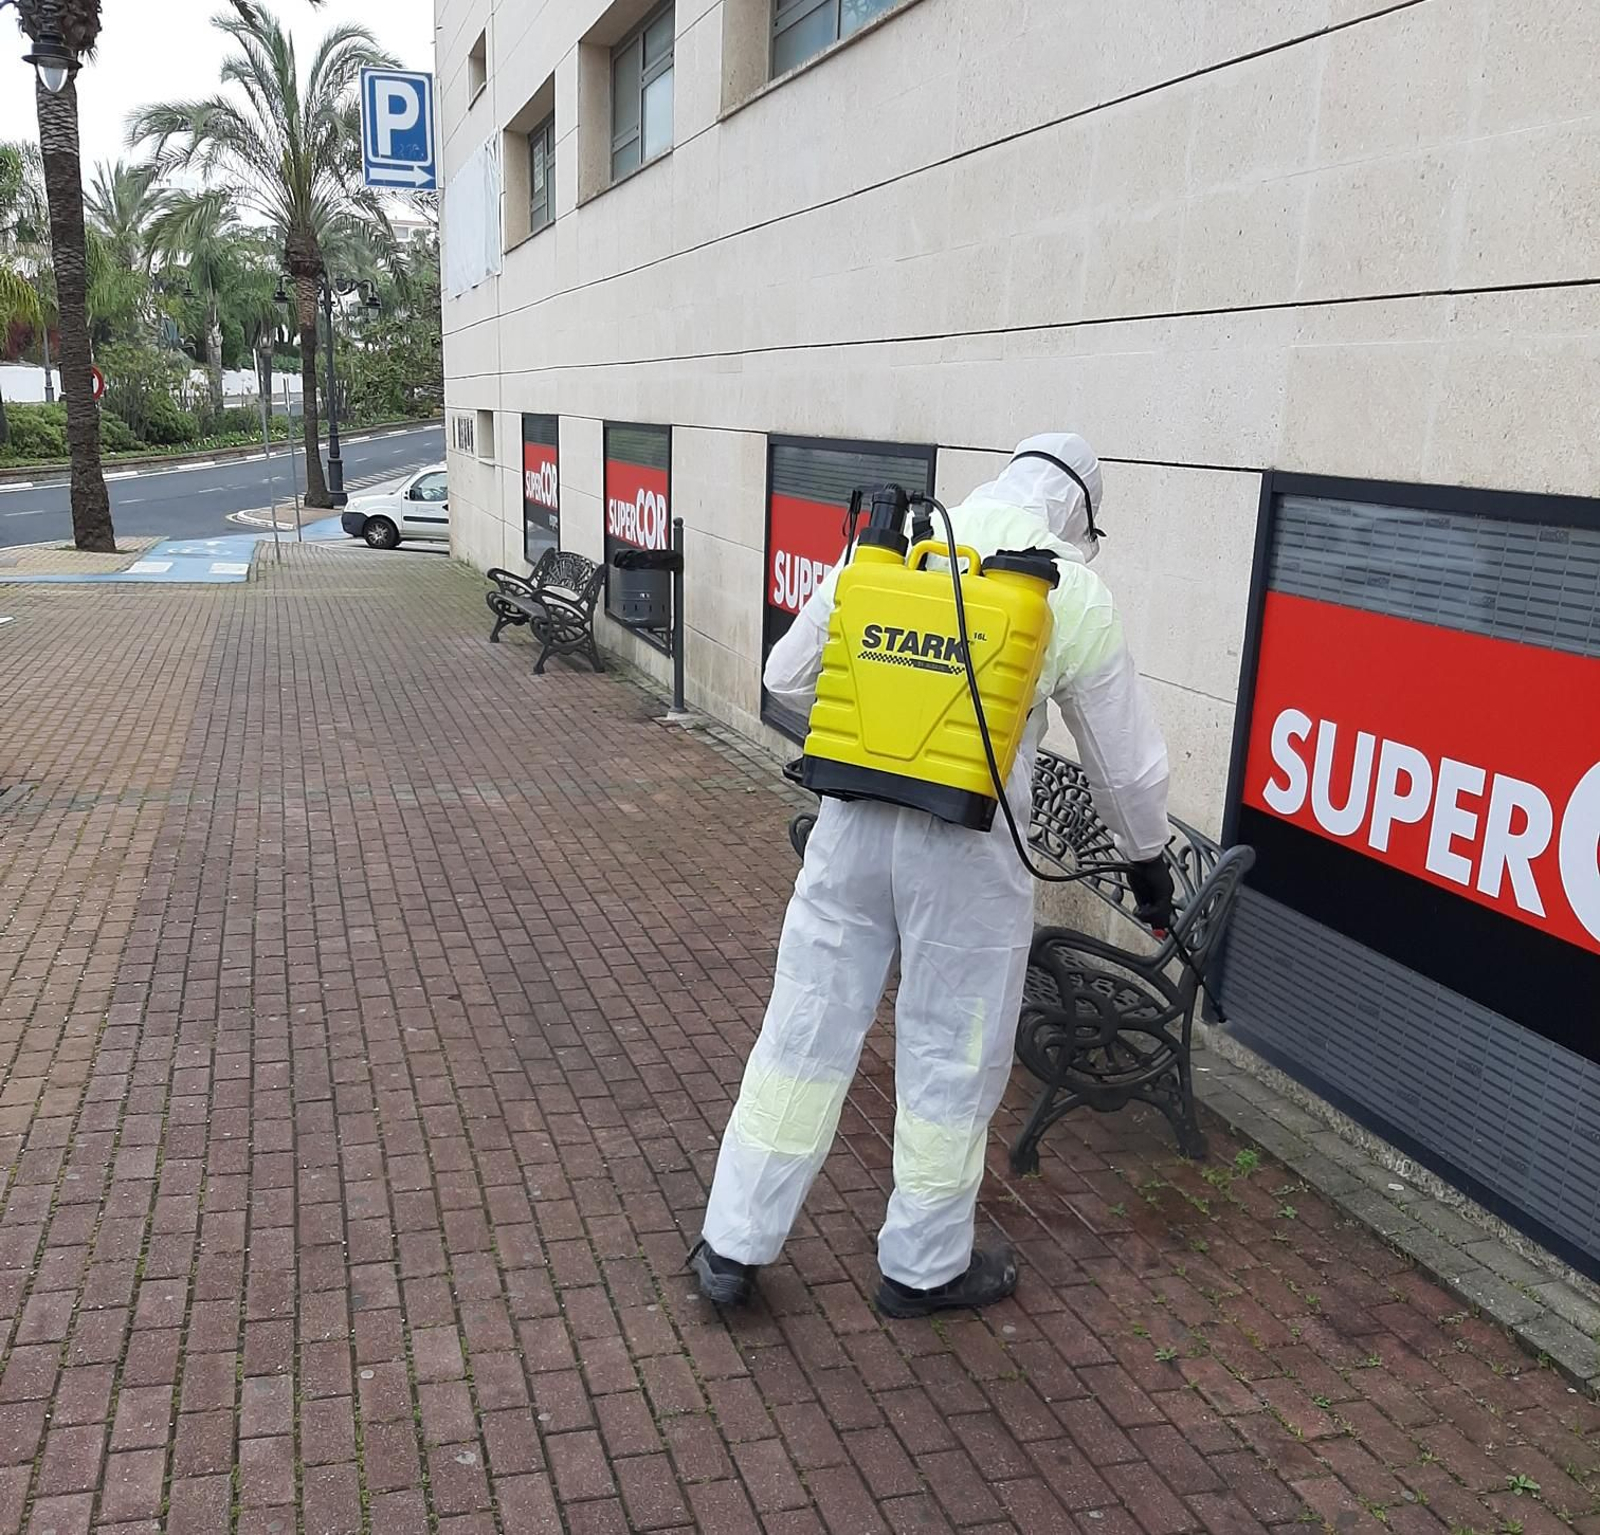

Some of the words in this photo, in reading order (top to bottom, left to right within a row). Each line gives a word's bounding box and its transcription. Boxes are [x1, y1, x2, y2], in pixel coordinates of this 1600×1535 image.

[375, 79, 420, 156] P
[608, 488, 667, 550] SUPERCOR
[773, 550, 833, 610] SUPE
[861, 624, 970, 664] STARK
